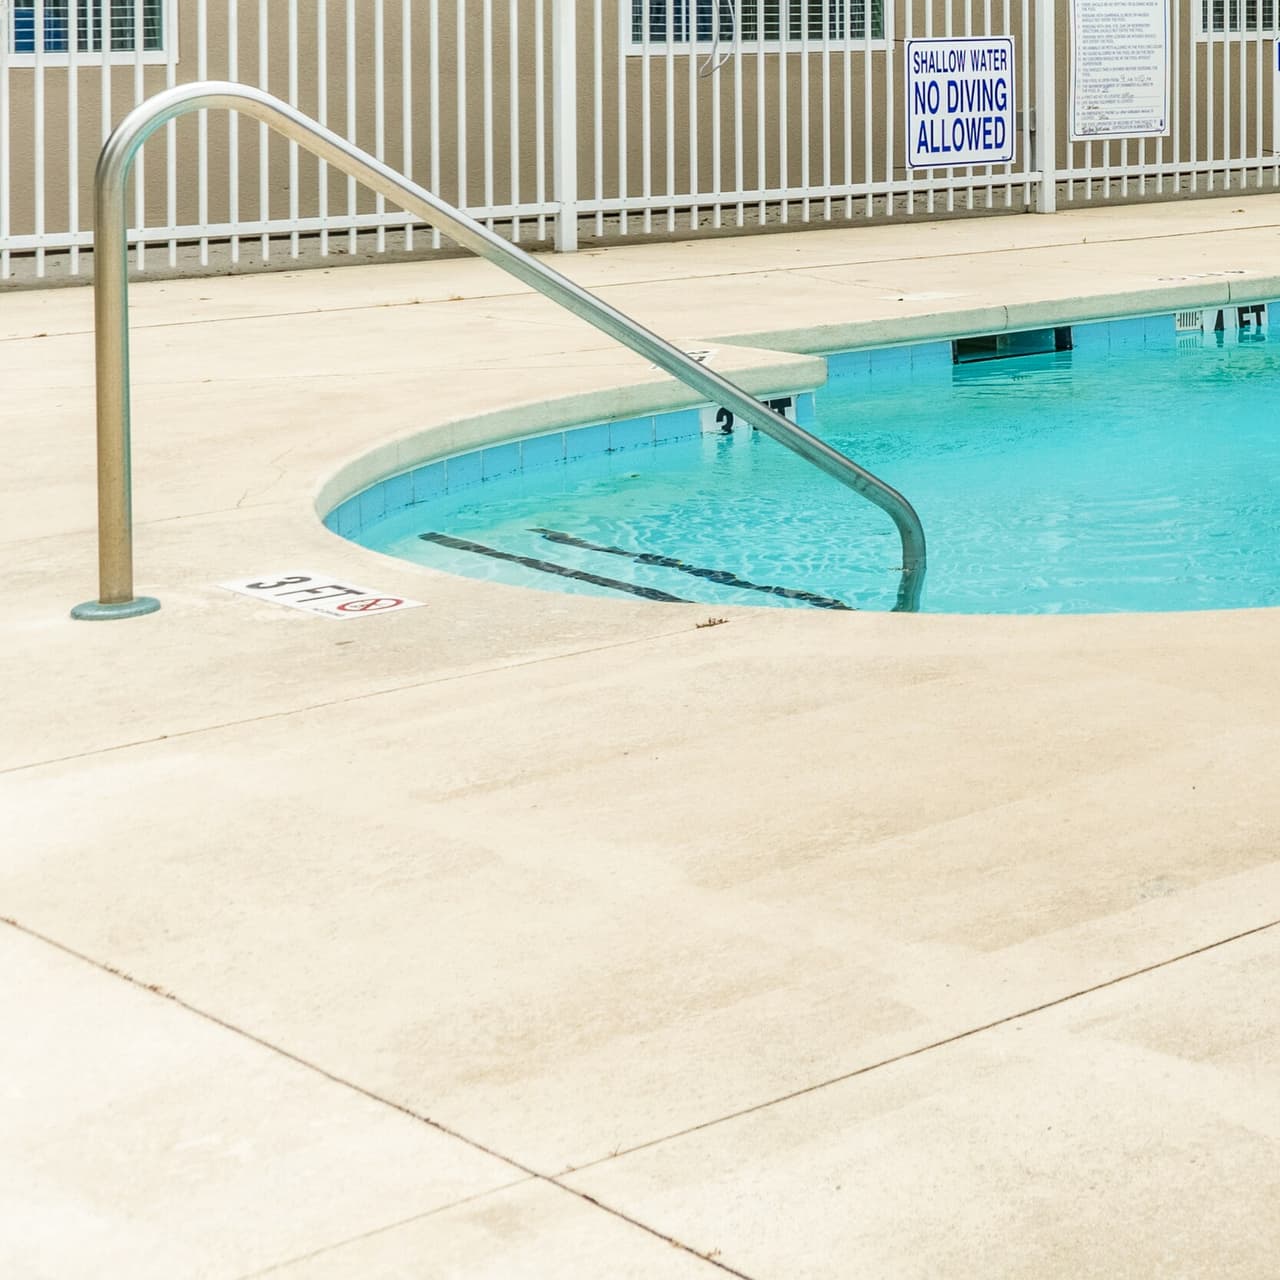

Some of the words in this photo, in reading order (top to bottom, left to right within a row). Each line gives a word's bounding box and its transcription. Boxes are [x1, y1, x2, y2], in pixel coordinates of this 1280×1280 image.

[913, 50, 966, 74] SHALLOW
[970, 49, 1007, 72] WATER
[914, 80, 939, 115] NO
[947, 78, 1007, 113] DIVING
[917, 116, 1005, 154] ALLOWED
[246, 576, 312, 589] 3
[274, 585, 366, 603] FT
